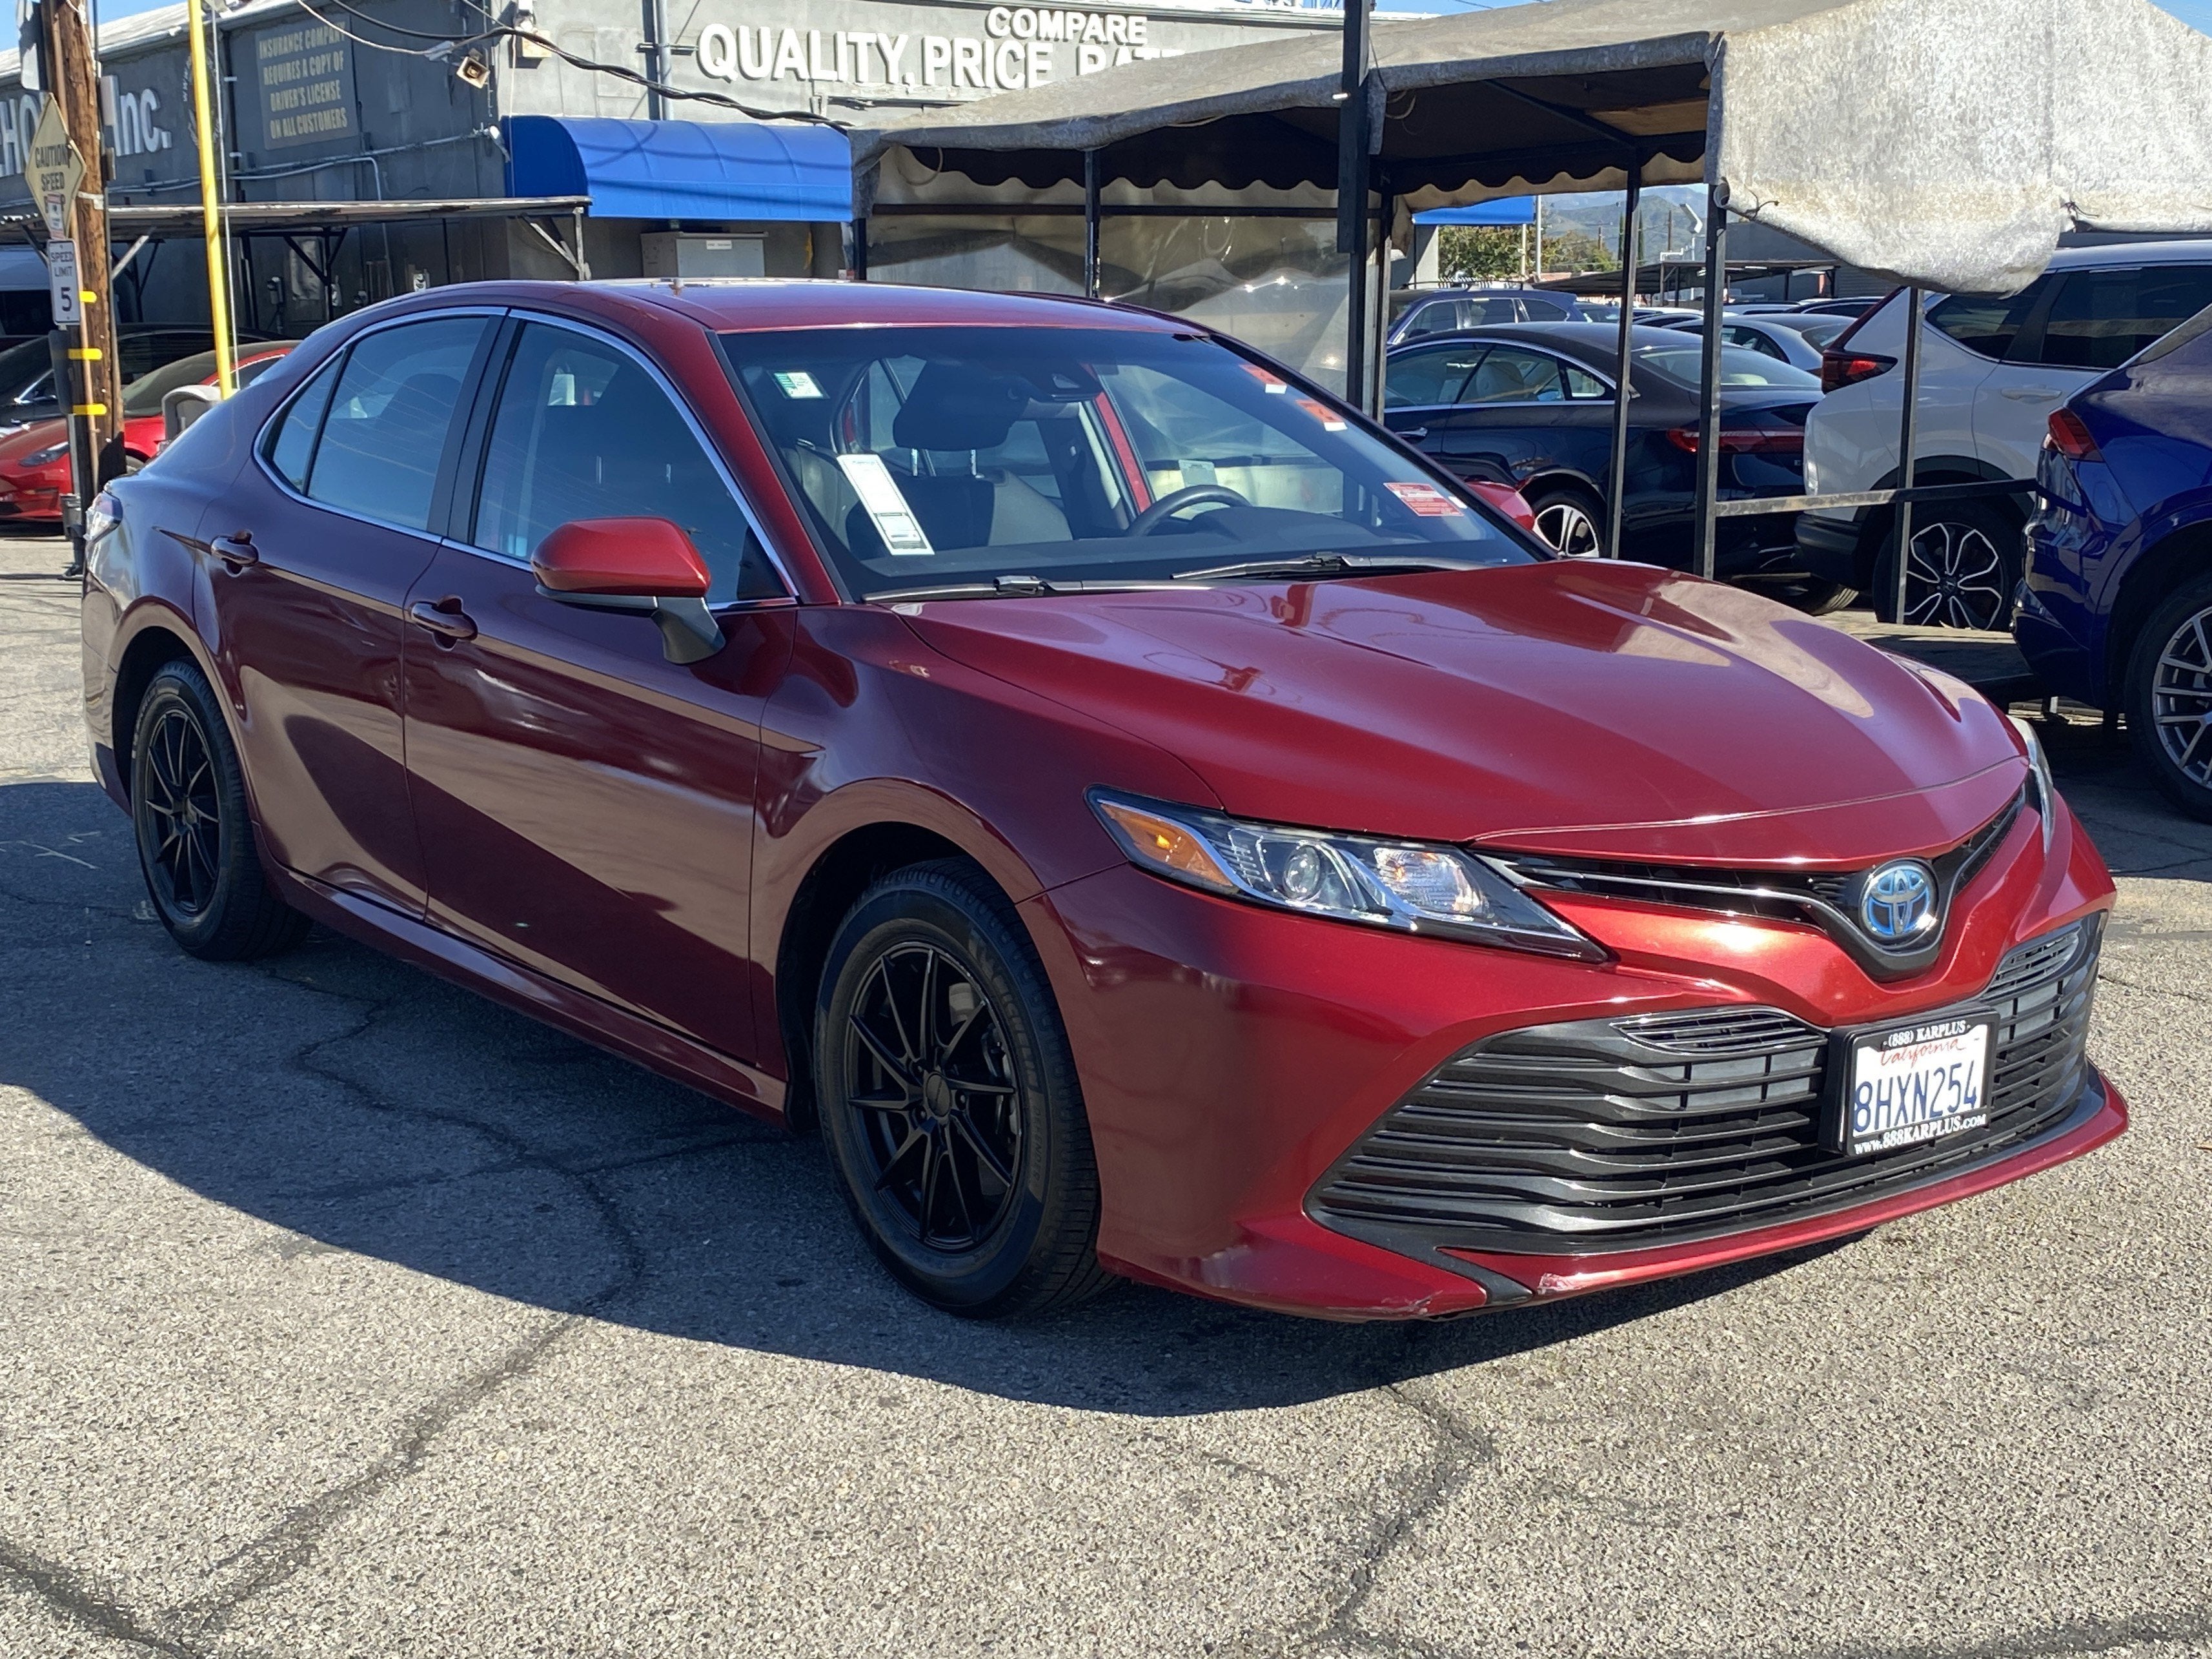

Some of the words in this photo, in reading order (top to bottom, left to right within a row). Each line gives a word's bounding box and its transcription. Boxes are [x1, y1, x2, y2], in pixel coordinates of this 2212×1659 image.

[259, 32, 303, 59] INSURANCE
[305, 21, 345, 49] COMPANY
[986, 6, 1148, 46] COMPARE
[263, 59, 301, 85] REQUIRES
[303, 59, 309, 77] A
[309, 52, 331, 76] COPY
[333, 50, 343, 71] OF
[922, 36, 1053, 90] PRICE
[270, 87, 306, 112] DRIVER'S
[307, 79, 341, 105] LICENSE
[110, 75, 172, 156] Inc.
[270, 119, 283, 139] ON
[282, 117, 297, 137] ALL
[296, 107, 347, 134] CUSTOMERS
[35, 144, 69, 168] CAUTION
[41, 172, 64, 191] SPEED
[50, 251, 74, 261] SPEED
[54, 266, 72, 277] LIMIT
[61, 287, 72, 311] 5
[1888, 1032, 1914, 1047] (888)
[1916, 1020, 1966, 1042] KARPLUS
[1880, 1038, 1966, 1068] California
[1853, 1060, 1977, 1132] 8HXN254
